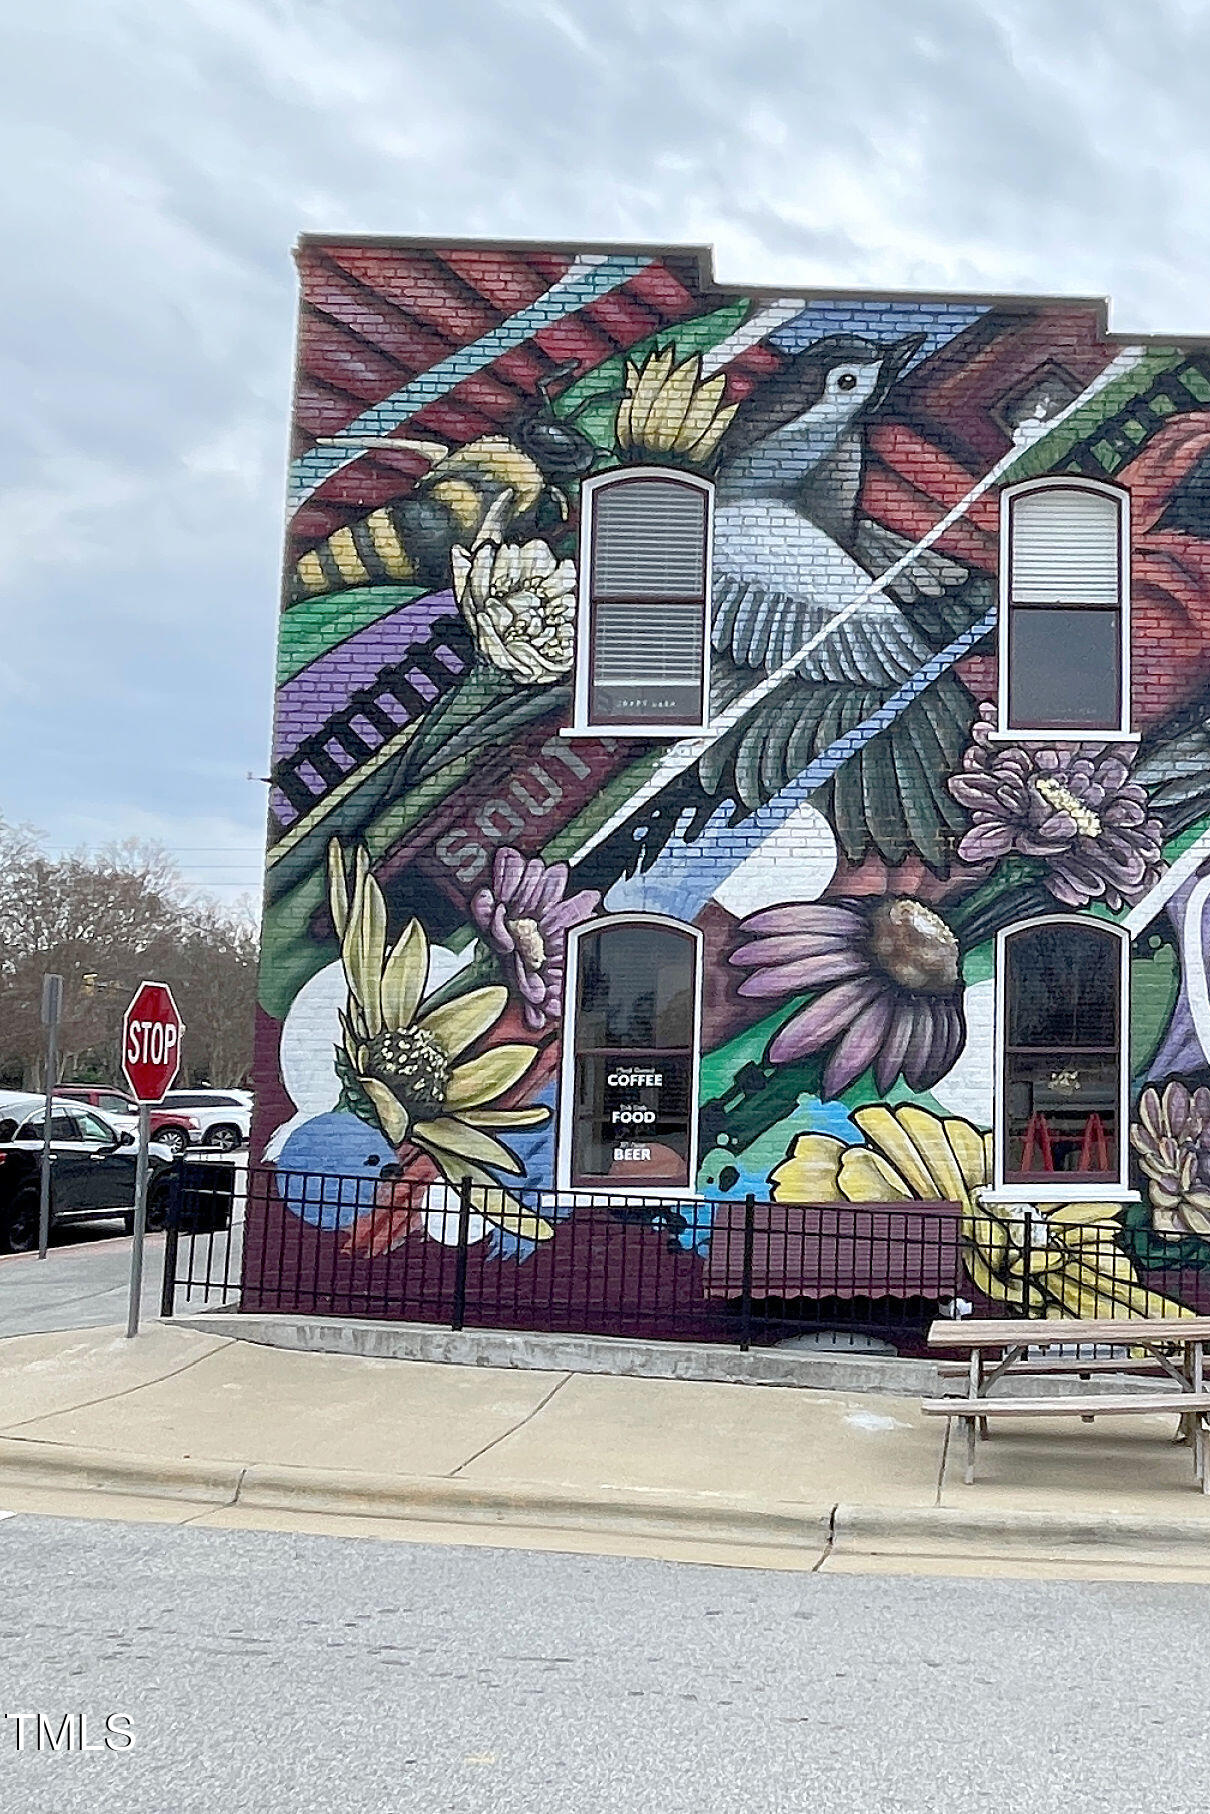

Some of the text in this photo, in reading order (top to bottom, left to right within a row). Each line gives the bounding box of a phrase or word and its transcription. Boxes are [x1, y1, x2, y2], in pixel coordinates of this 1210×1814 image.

[435, 735, 620, 883] SOUT
[127, 1019, 178, 1065] STOP
[607, 1073, 663, 1087] COFFEE
[612, 1111, 656, 1124] FOOD
[613, 1148, 651, 1161] BEER
